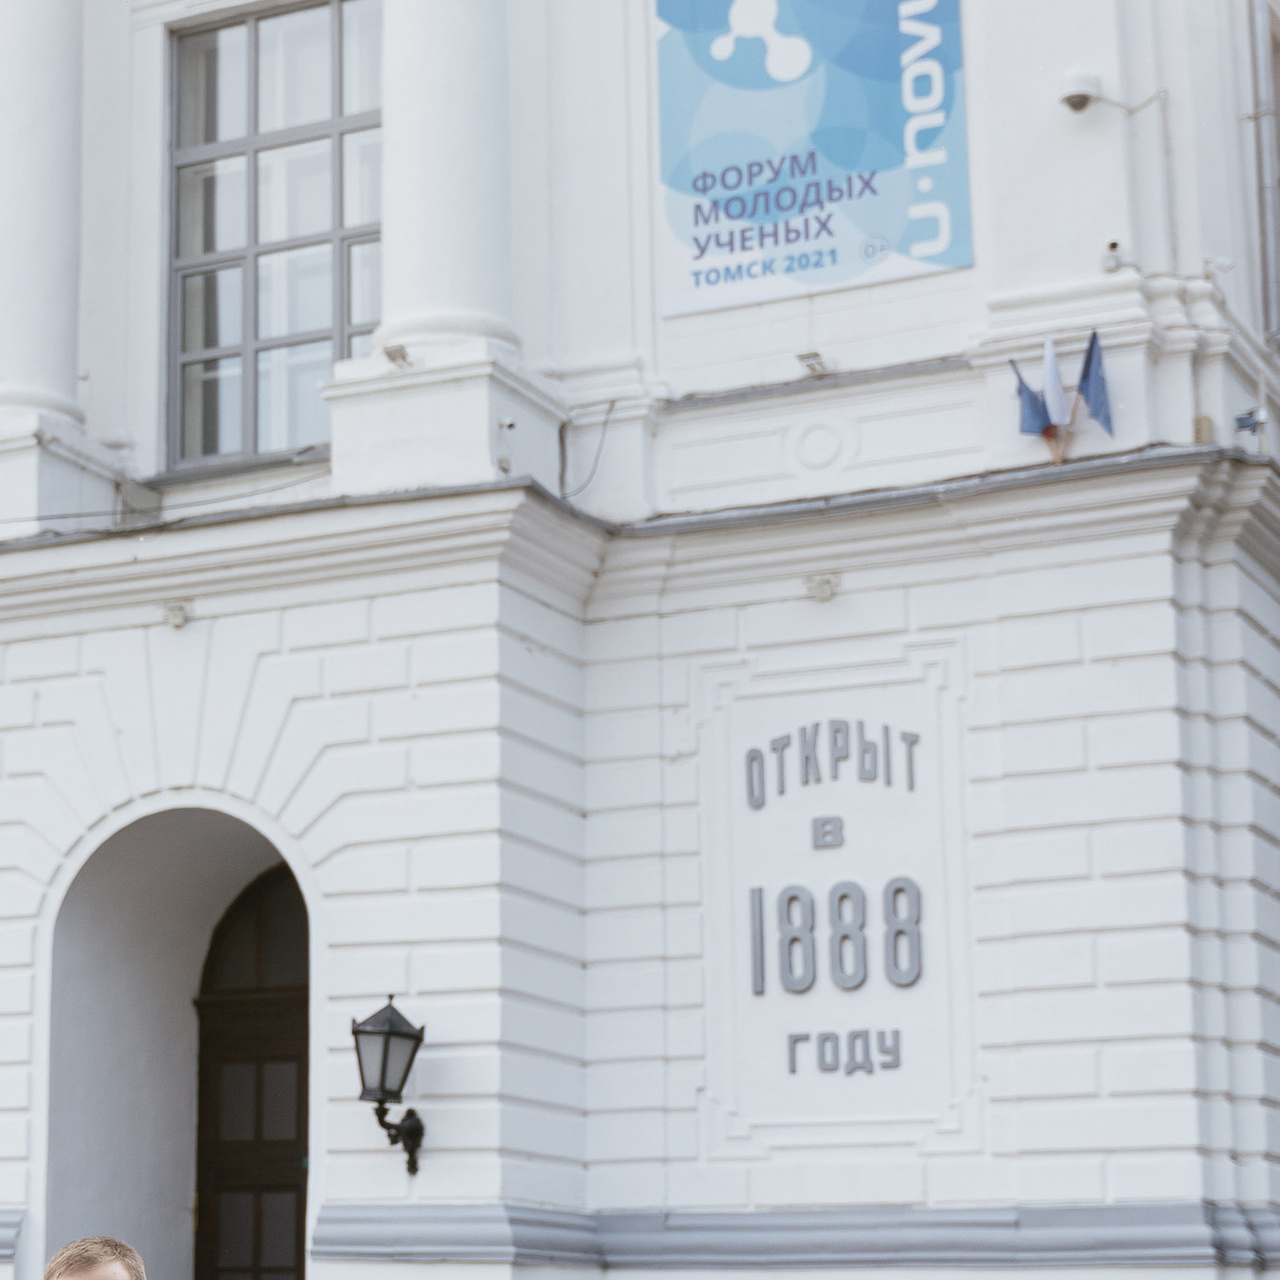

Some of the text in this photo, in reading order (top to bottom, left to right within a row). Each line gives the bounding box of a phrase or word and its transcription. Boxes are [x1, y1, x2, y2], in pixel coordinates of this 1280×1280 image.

[691, 151, 818, 196] ФОРУМ
[693, 170, 879, 227] МОЛОДЫХ
[692, 213, 835, 261] УЧЕНЫХ
[691, 248, 840, 288] ТОМСК 2021
[745, 719, 920, 810] ОТКРЫТ
[812, 816, 844, 849] В
[750, 876, 922, 996] 1888
